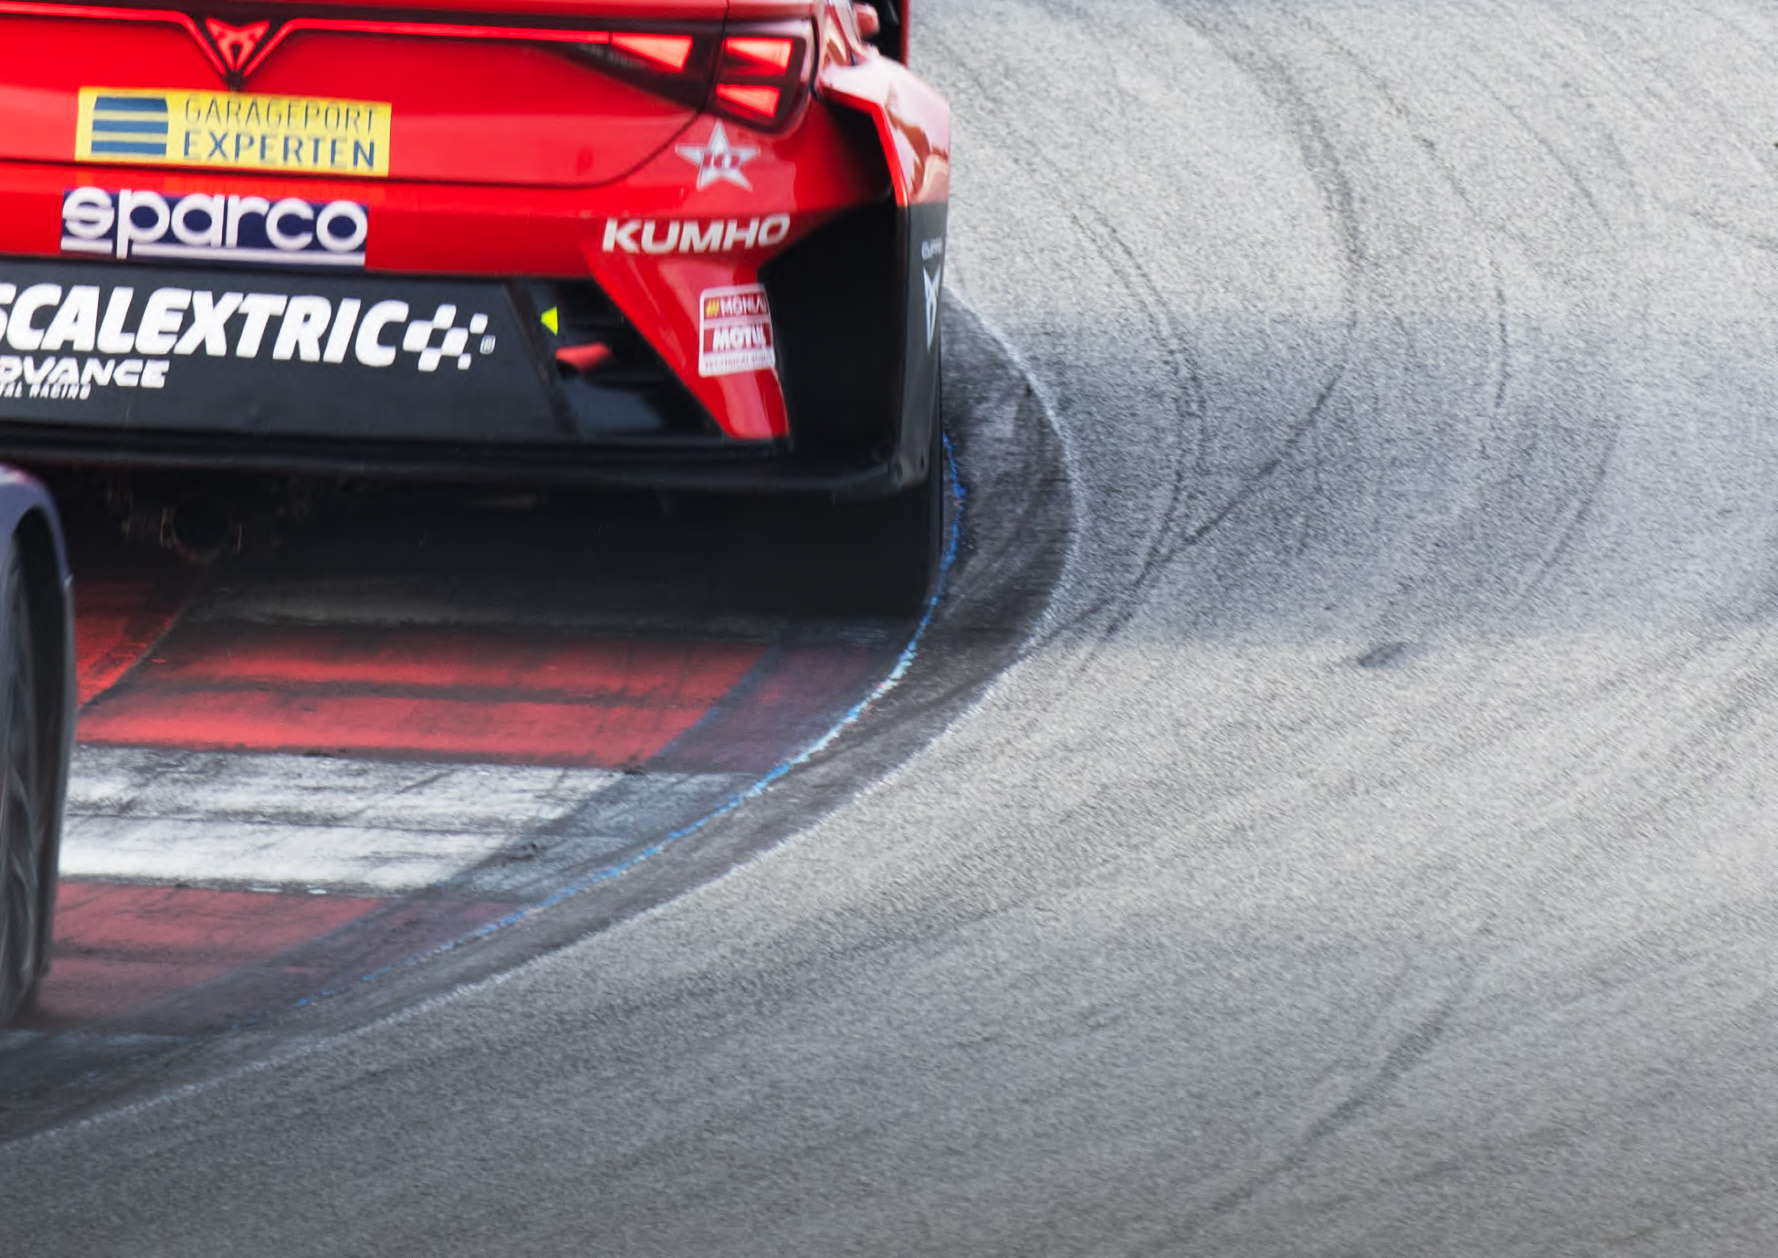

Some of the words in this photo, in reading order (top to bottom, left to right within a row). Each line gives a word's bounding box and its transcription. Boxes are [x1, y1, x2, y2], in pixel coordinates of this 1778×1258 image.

[185, 93, 377, 134] GARAGEPORT
[183, 129, 375, 169] EXPERTEN
[61, 186, 368, 260] sparco
[602, 213, 790, 253] KUMHO
